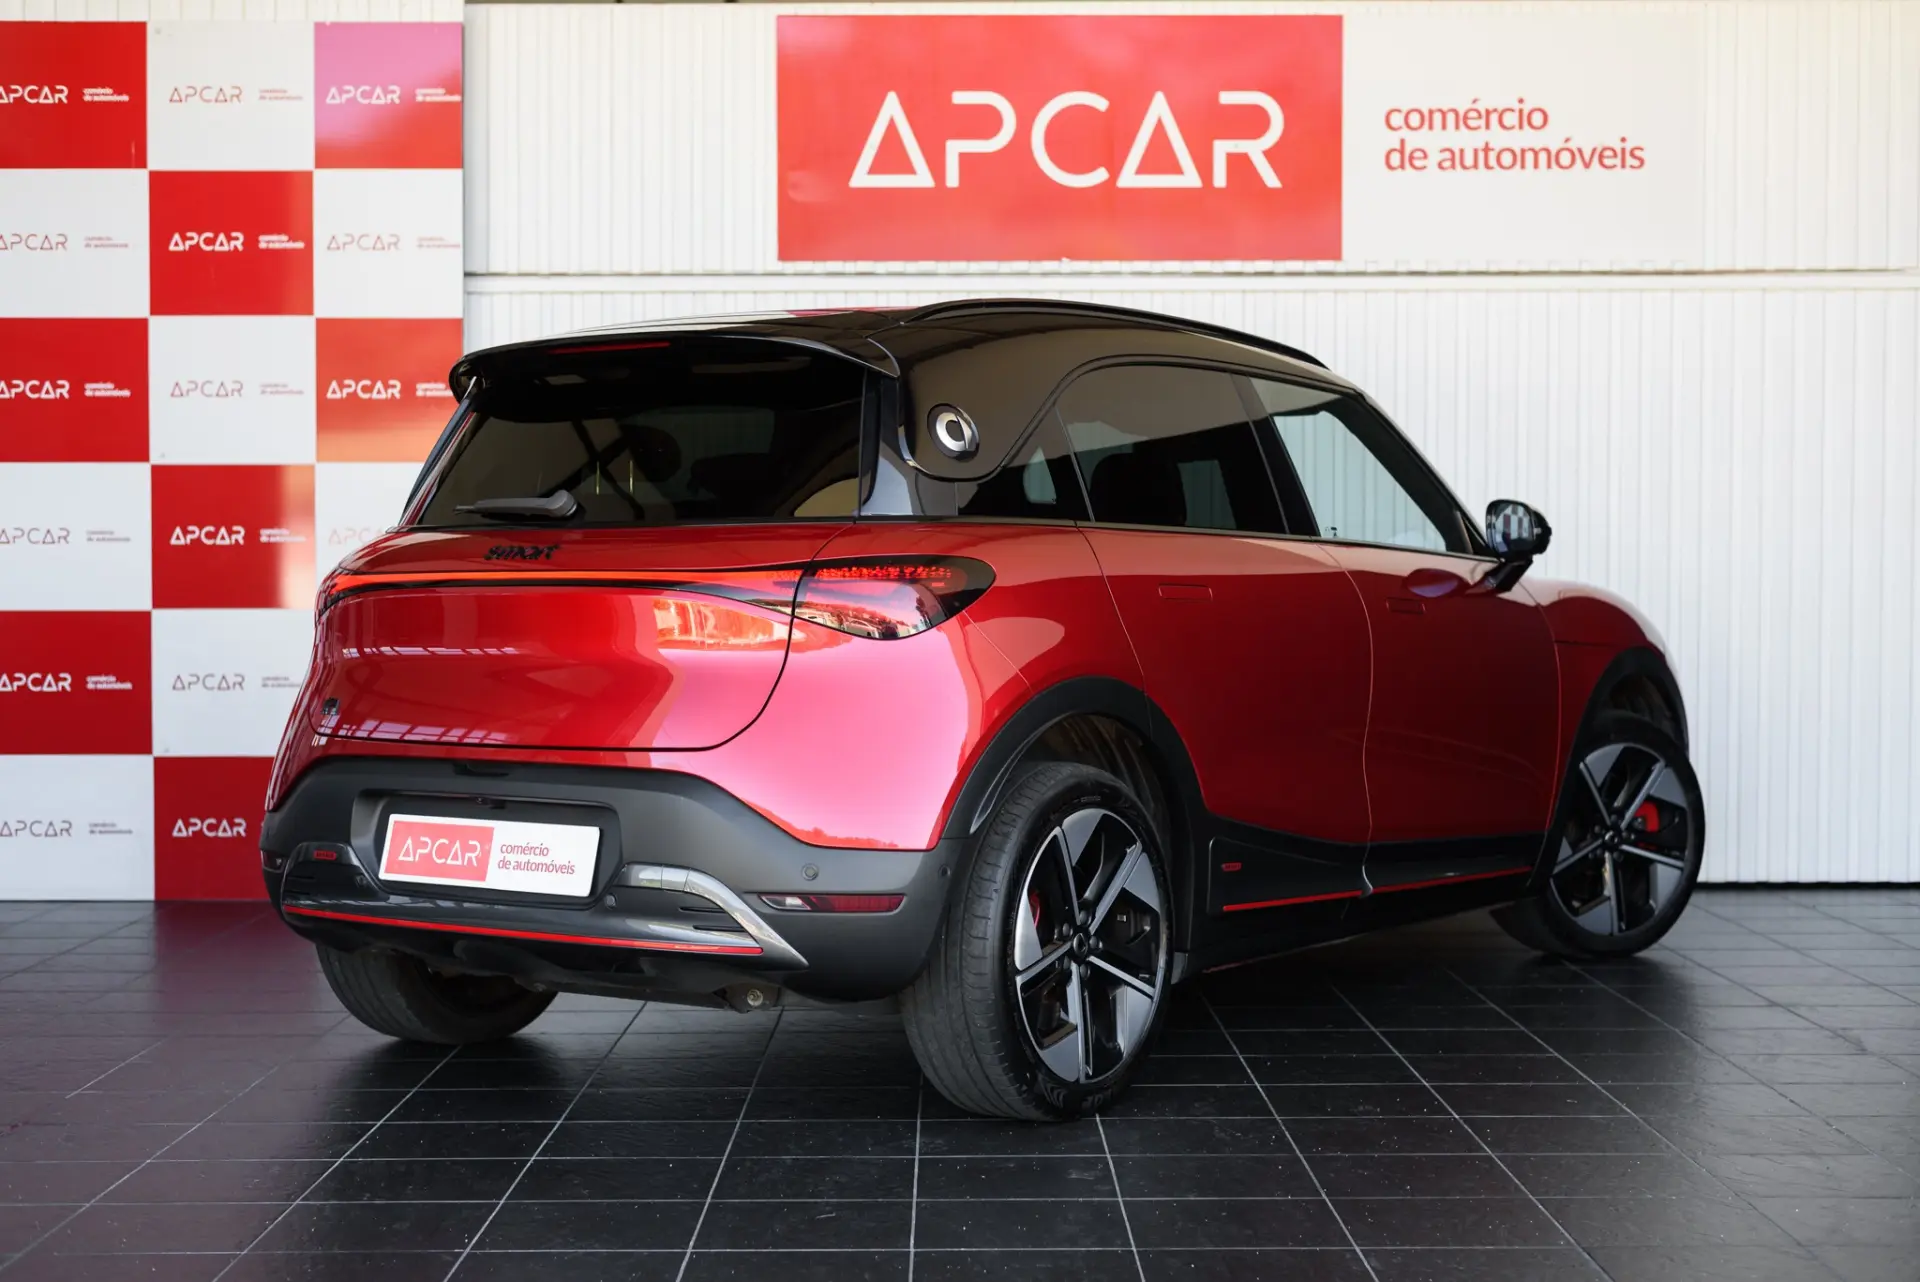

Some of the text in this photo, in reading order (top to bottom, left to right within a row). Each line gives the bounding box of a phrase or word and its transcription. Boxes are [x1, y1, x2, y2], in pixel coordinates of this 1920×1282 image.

[169, 86, 242, 103] APCAR
[326, 85, 401, 104] APCAR
[1384, 98, 1548, 132] comércio
[849, 91, 1285, 188] APCAR
[1384, 137, 1646, 171] de automóveis
[169, 232, 244, 251] APCAR
[327, 233, 400, 251] APCAR
[170, 380, 243, 398] APCAR
[326, 380, 401, 399] APCAR
[170, 526, 245, 545] APCAR
[172, 674, 245, 691] APCAR
[172, 818, 246, 837] APCAR
[398, 836, 482, 867] APCAR
[500, 843, 550, 857] comércio
[498, 856, 576, 875] de automóveis
